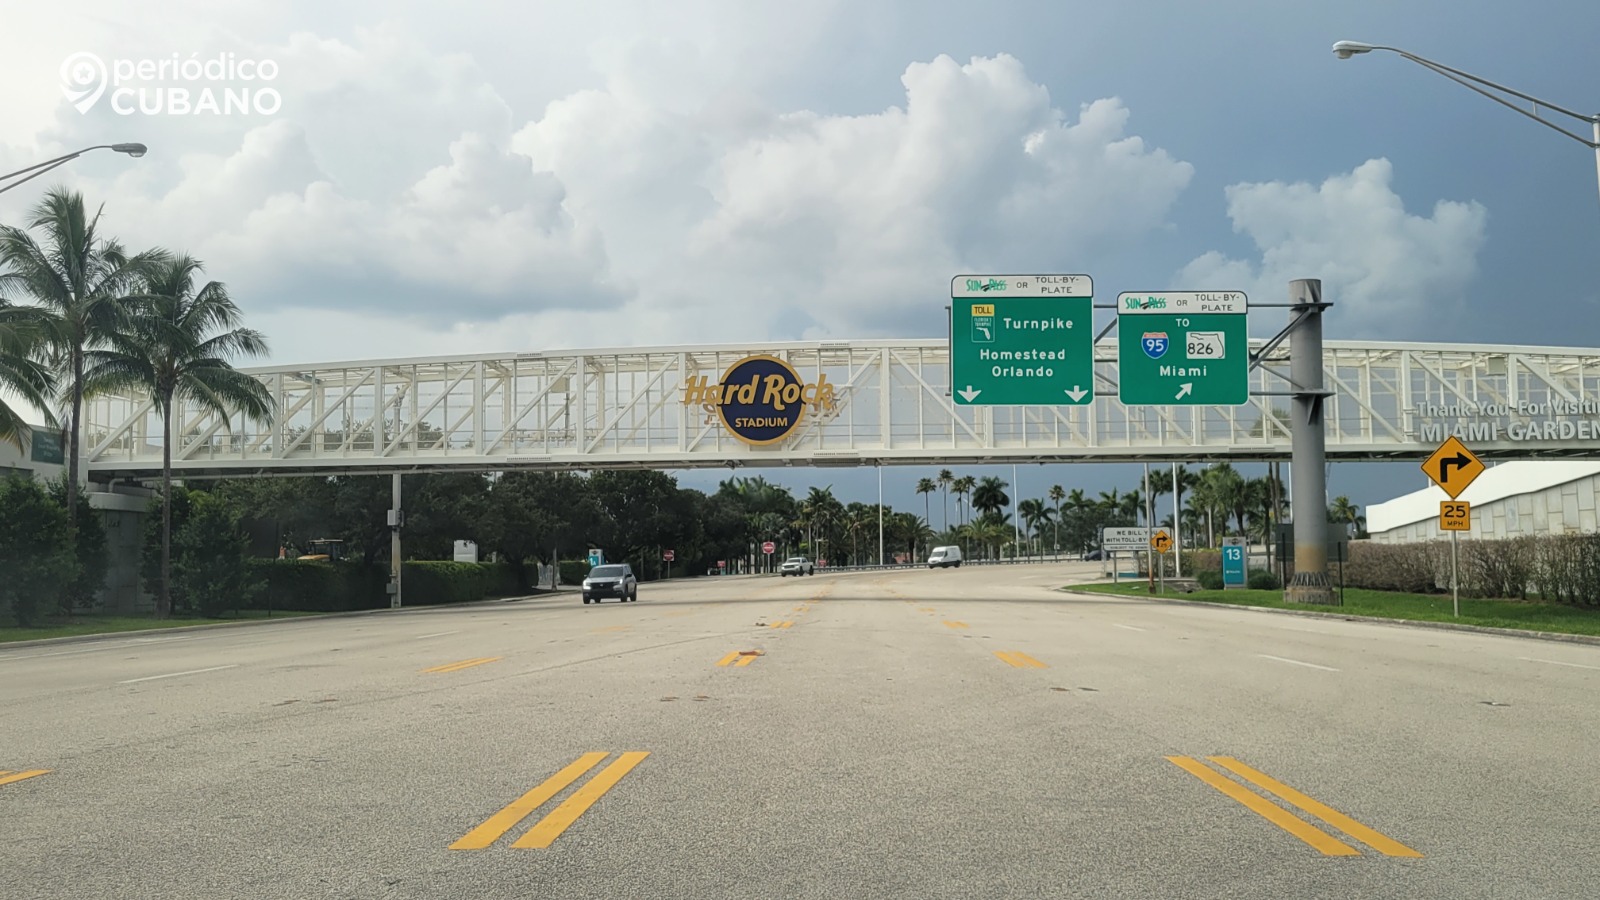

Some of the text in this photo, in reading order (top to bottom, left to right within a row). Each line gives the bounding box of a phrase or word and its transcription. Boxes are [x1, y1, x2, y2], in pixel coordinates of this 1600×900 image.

[1016, 281, 1028, 289] OR
[1035, 276, 1080, 284] TOLL-BY-
[1041, 286, 1073, 294] PLATE
[1176, 299, 1188, 307] OR
[1201, 304, 1233, 312] PLATE
[974, 306, 993, 314] TOLL
[1003, 318, 1074, 332] Turnpike
[1175, 318, 1190, 328] TO
[1146, 339, 1164, 352] 95
[1187, 342, 1214, 355] 826
[980, 348, 1066, 361] Homestead
[992, 365, 1054, 377] Orlando
[1159, 365, 1207, 377] Miami
[683, 373, 834, 411] Hard Rock
[1416, 401, 1471, 417] Thank
[1476, 400, 1509, 416] You
[1518, 400, 1547, 415] For
[735, 417, 788, 428] STADIUM
[1420, 422, 1497, 442] MIAMI
[1444, 505, 1466, 518] 25
[1226, 549, 1241, 560] 13
